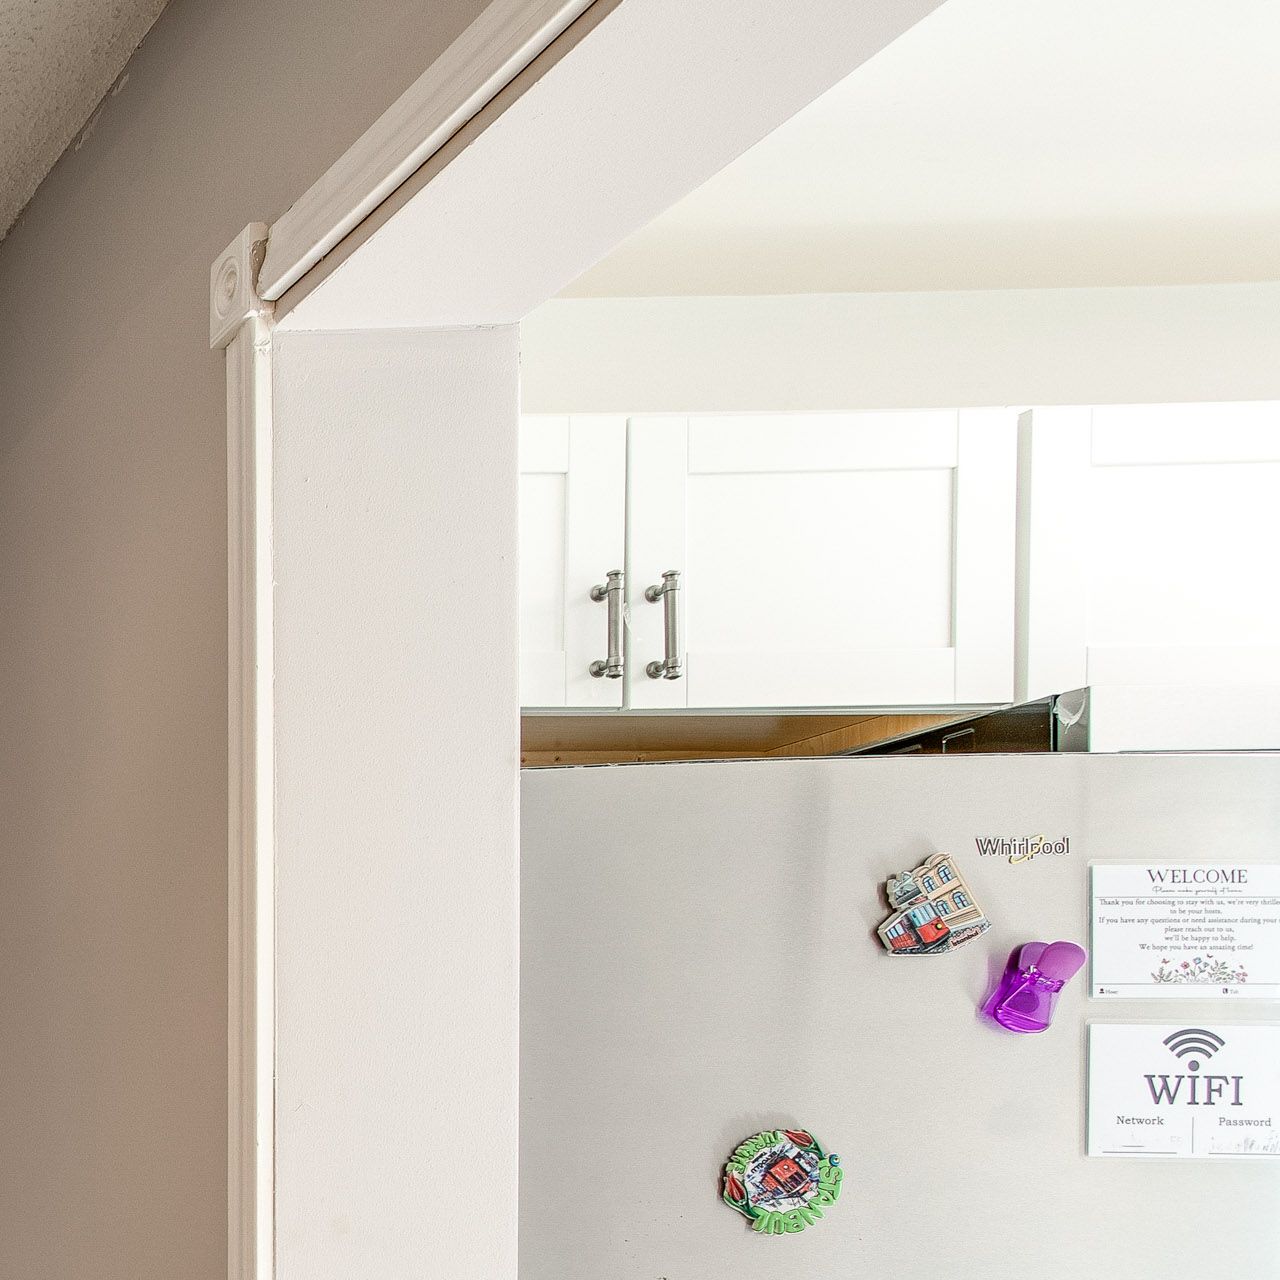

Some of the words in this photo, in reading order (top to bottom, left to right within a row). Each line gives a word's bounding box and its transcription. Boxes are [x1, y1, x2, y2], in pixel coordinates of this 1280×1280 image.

[976, 836, 1070, 860] Whirlpool
[1146, 869, 1248, 884] WELCOME
[1146, 899, 1176, 907] choosing
[1150, 917, 1181, 925] questions
[1240, 916, 1261, 925] during
[1191, 935, 1210, 943] happy
[1152, 944, 1168, 952] hope
[1209, 944, 1236, 952] amazing
[1143, 1074, 1244, 1106] WIFI
[1116, 1115, 1165, 1126] Network
[1218, 1117, 1272, 1127] Password
